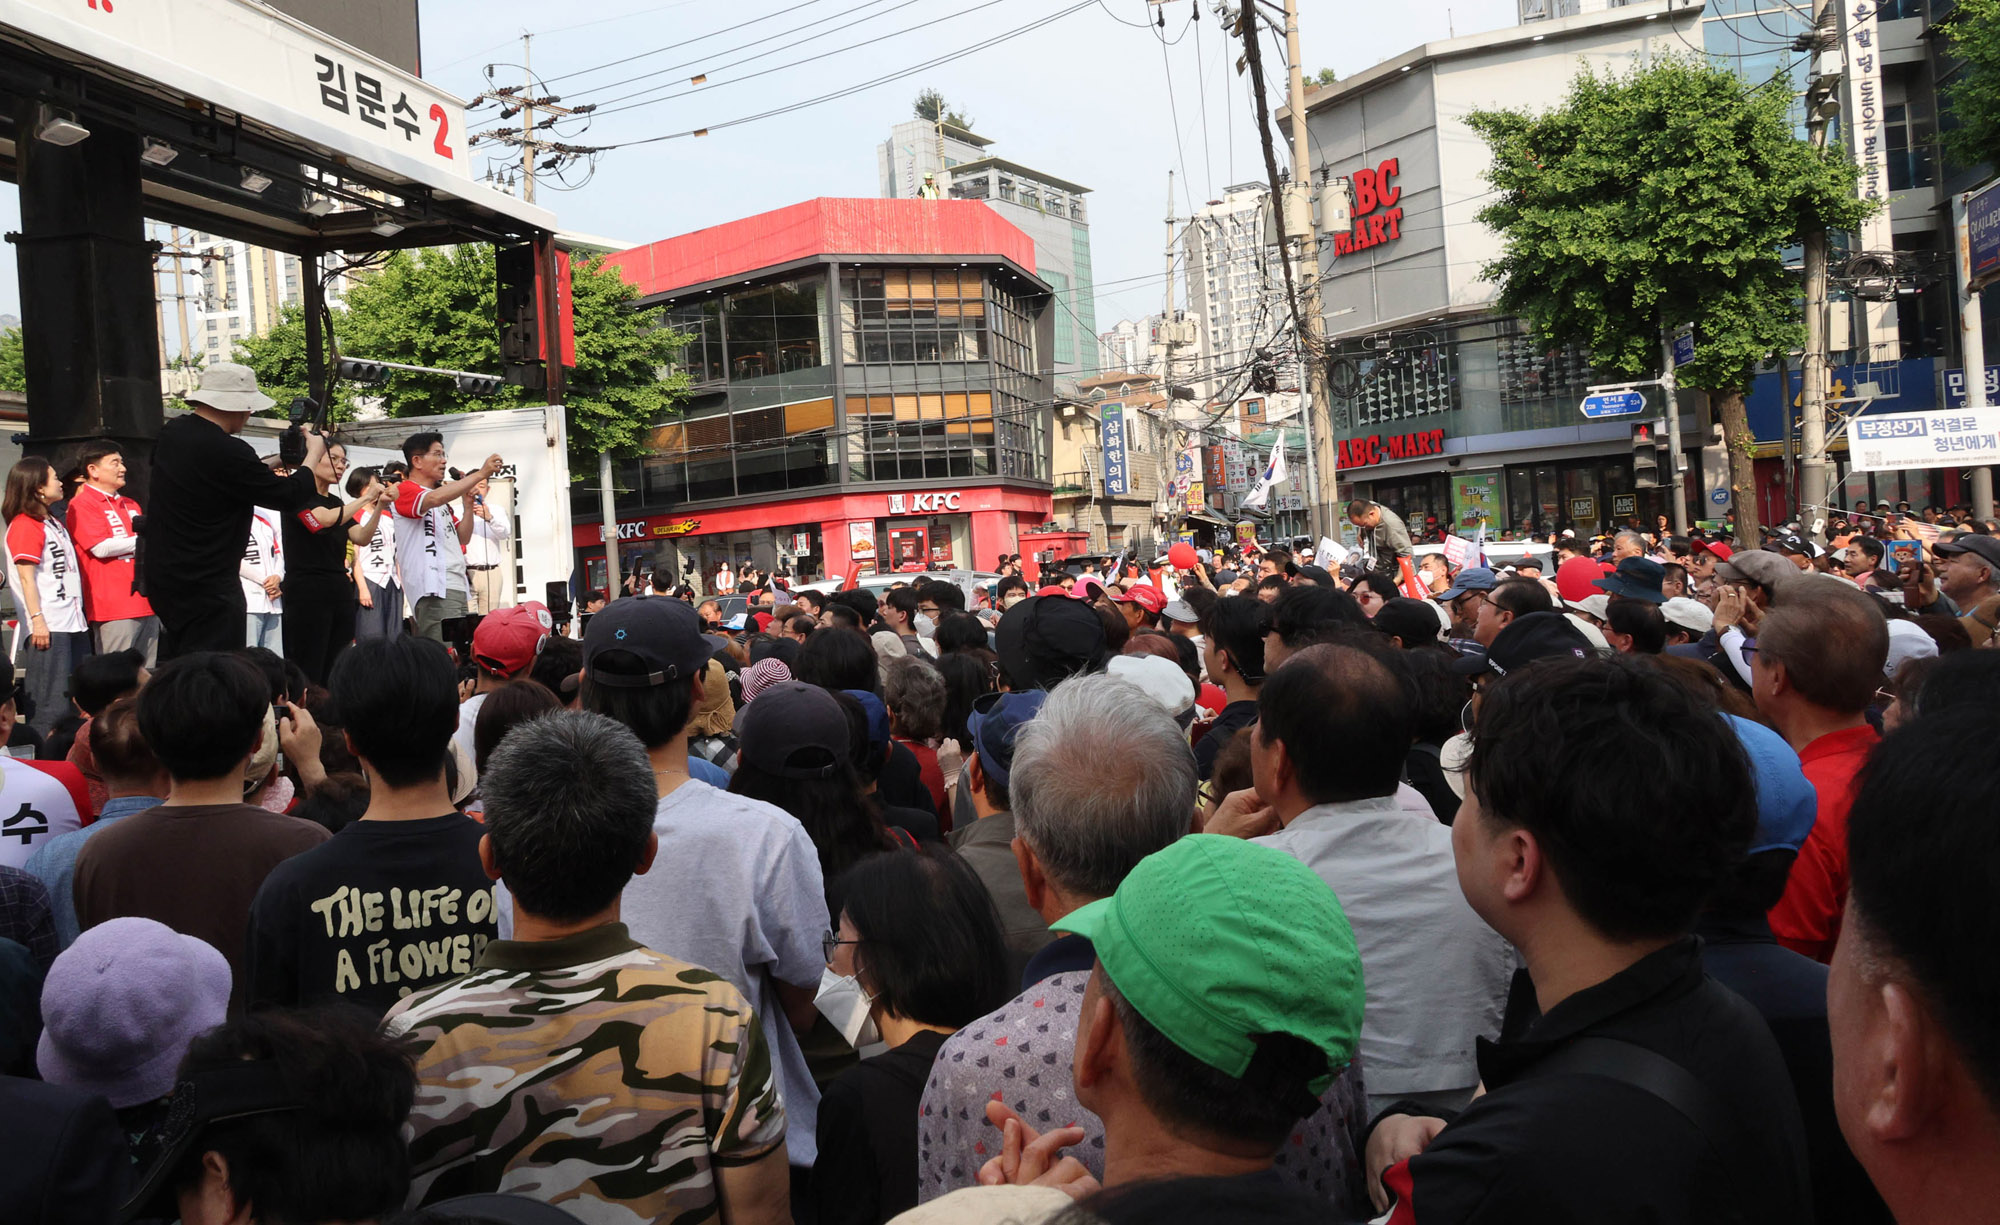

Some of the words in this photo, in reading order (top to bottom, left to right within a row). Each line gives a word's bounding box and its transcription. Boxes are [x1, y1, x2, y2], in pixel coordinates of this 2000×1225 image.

[314, 53, 421, 141] 김문수
[429, 103, 454, 160] 2
[1860, 81, 1876, 131] UNION
[1342, 157, 1402, 218] BC
[1334, 207, 1403, 257] MART
[1336, 428, 1445, 469] ABC-MART
[1861, 420, 1924, 438] 부정선거
[1931, 417, 1978, 433] 척결로
[1934, 434, 1997, 453] 청년에게
[1106, 421, 1123, 492] 삼화한의원
[305, 512, 320, 528] PRESS
[911, 492, 961, 513] KFC
[1574, 502, 1591, 510] ABC
[1616, 498, 1634, 507] ABC
[616, 521, 646, 540] KFC
[1, 802, 48, 845] 수
[311, 885, 385, 938] THE
[389, 885, 462, 930] LIFE
[335, 948, 361, 994] A
